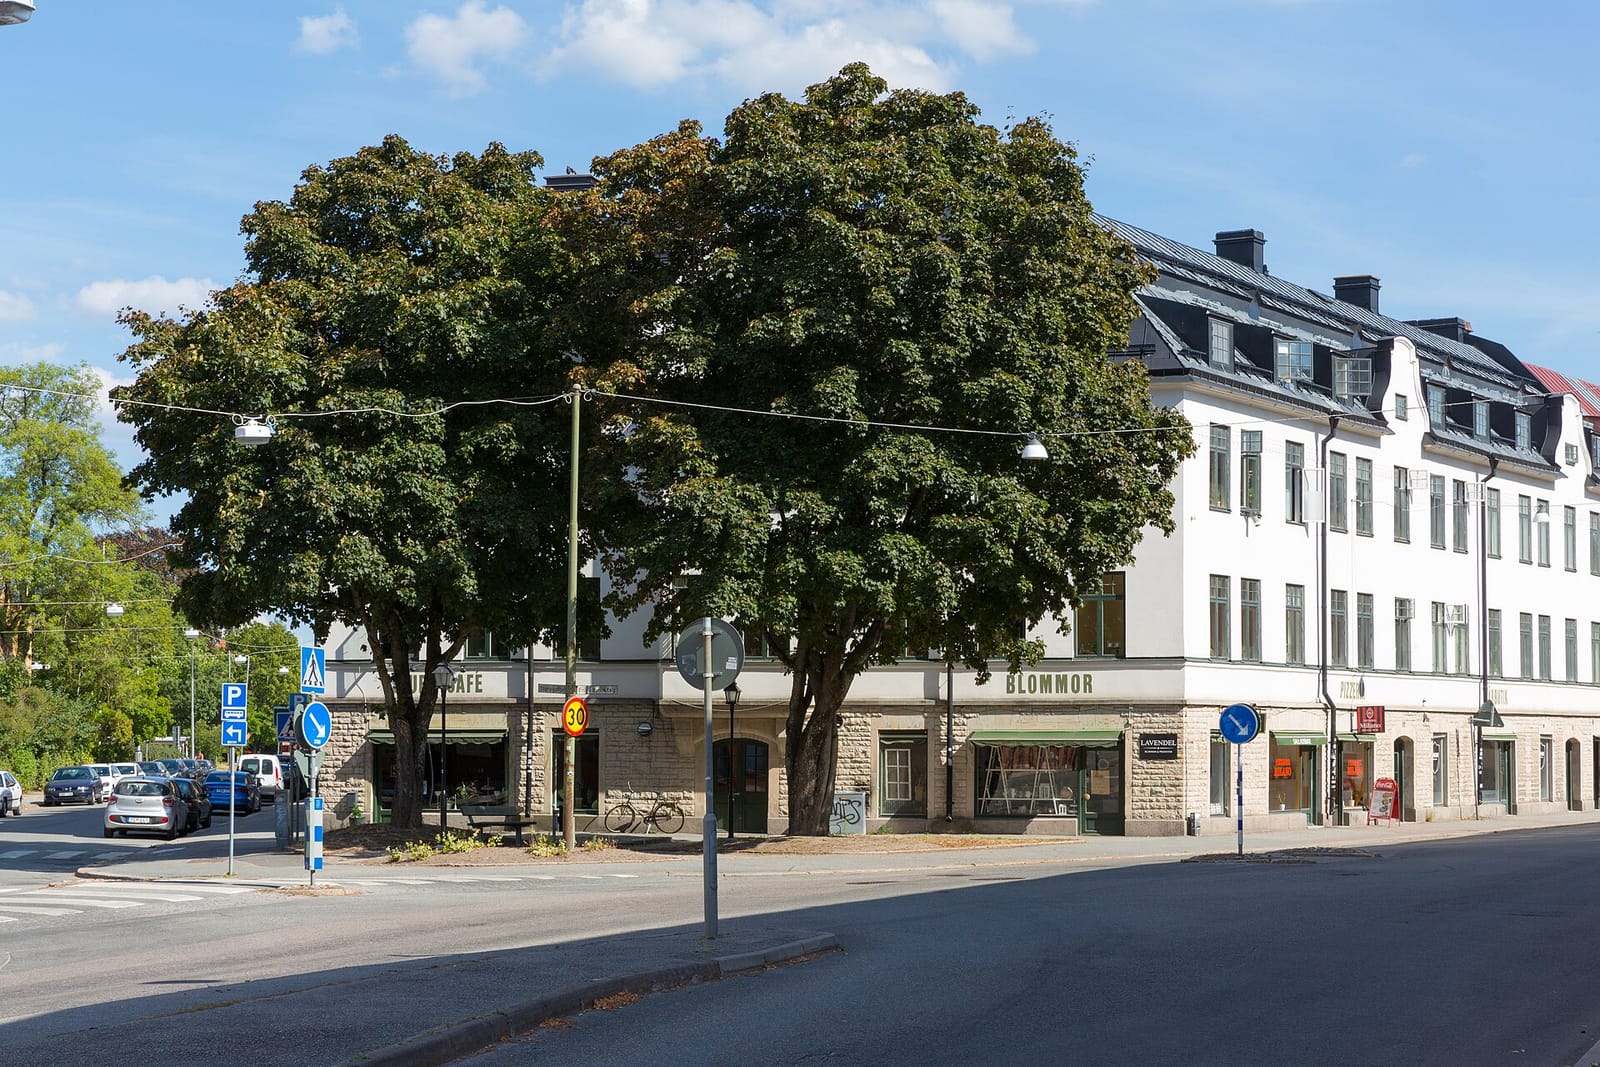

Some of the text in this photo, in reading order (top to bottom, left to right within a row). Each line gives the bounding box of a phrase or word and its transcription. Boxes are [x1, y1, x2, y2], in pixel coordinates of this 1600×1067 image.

[1006, 674, 1093, 694] BLOMMOR
[227, 686, 242, 706] P
[567, 708, 585, 726] 30
